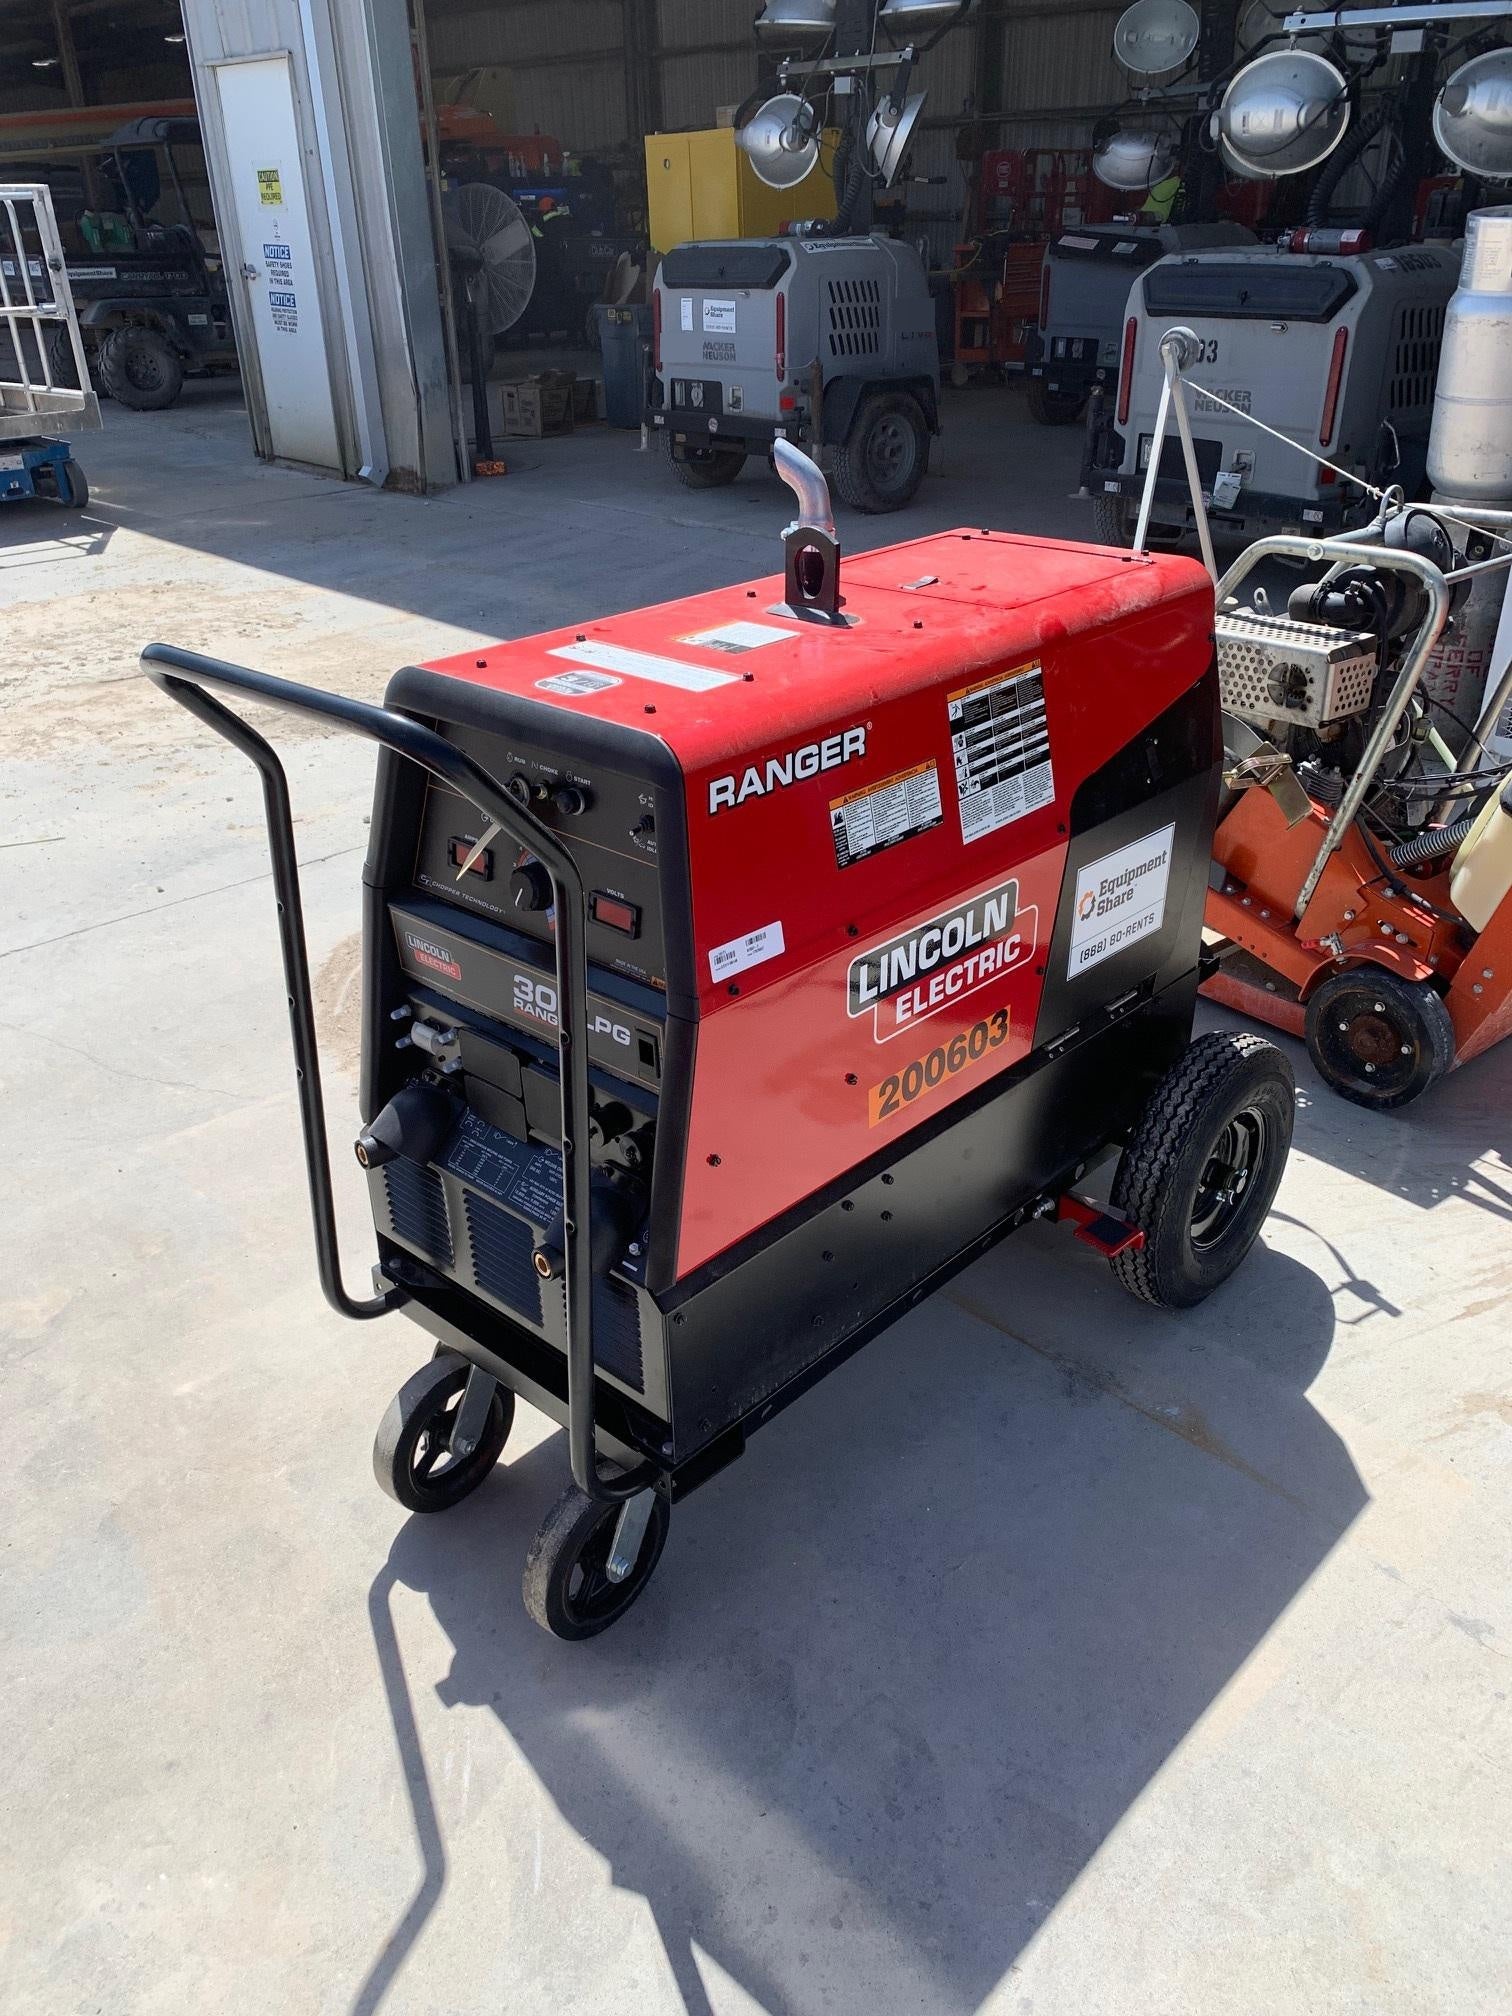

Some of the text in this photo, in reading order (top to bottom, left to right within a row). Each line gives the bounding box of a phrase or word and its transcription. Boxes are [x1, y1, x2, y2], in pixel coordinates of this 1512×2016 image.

[264, 245, 290, 259] NOTICE
[279, 261, 293, 269] SHOES
[270, 269, 290, 277] REQUIRED
[269, 292, 296, 307] NOTICE
[703, 351, 737, 362] NEUSON
[540, 764, 559, 776] CHOKE
[573, 775, 592, 786] START
[709, 726, 866, 814] RANGER
[1099, 850, 1168, 898] Equipment
[432, 881, 460, 896] CHOPPER
[462, 893, 502, 914] TECHNOLOGY
[606, 887, 625, 899] VOLTS
[1096, 887, 1135, 918] Share
[408, 934, 450, 962] LINCOLN
[859, 893, 1009, 1004] LINCOLN
[1079, 937, 1107, 964] (888)
[419, 953, 457, 977] ELECTRIC
[896, 934, 1022, 1025] ELECTRIC
[513, 974, 558, 1013] 30
[513, 998, 559, 1026] RANG
[878, 1008, 1009, 1120] 200603
